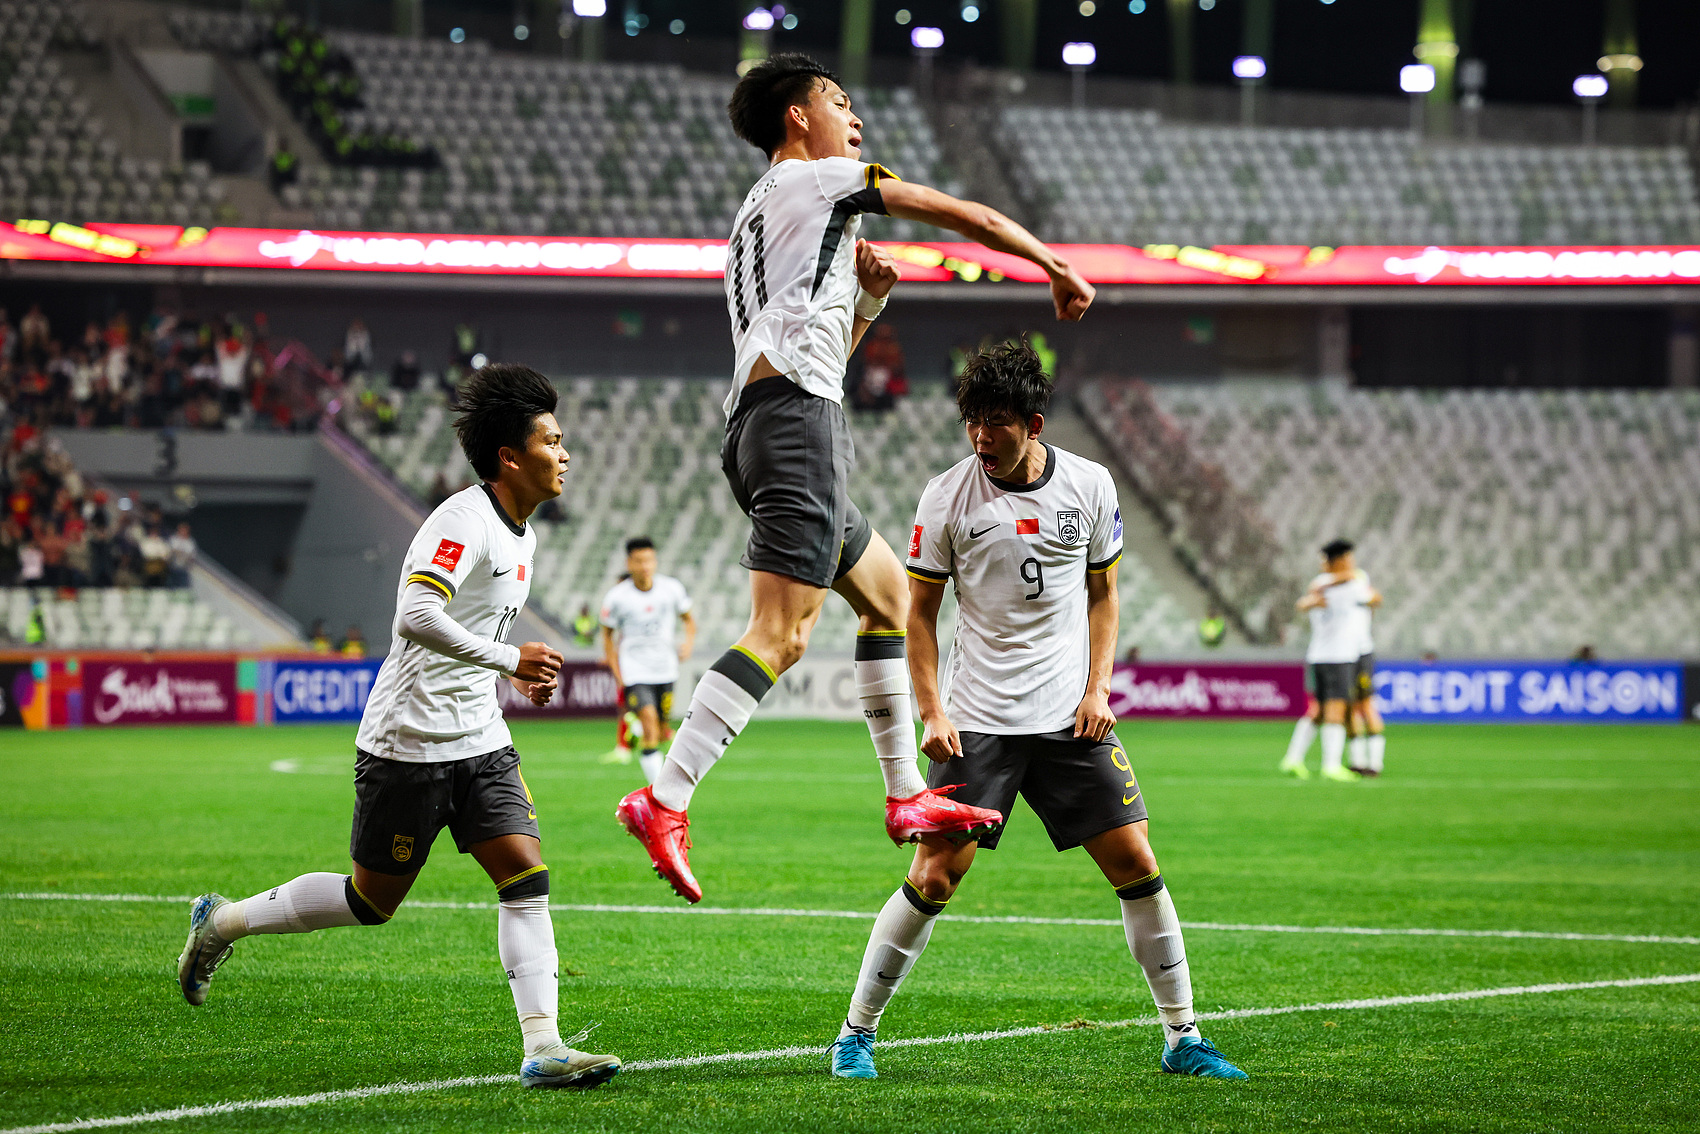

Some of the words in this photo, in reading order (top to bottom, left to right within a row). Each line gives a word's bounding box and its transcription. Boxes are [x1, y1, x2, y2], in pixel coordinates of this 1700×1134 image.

[732, 213, 769, 334] 11
[1020, 557, 1045, 600] 9
[274, 669, 374, 713] CREDIT
[1372, 670, 1513, 714] CREDIT
[1518, 670, 1678, 714] SAISON
[1110, 747, 1135, 788] 9
